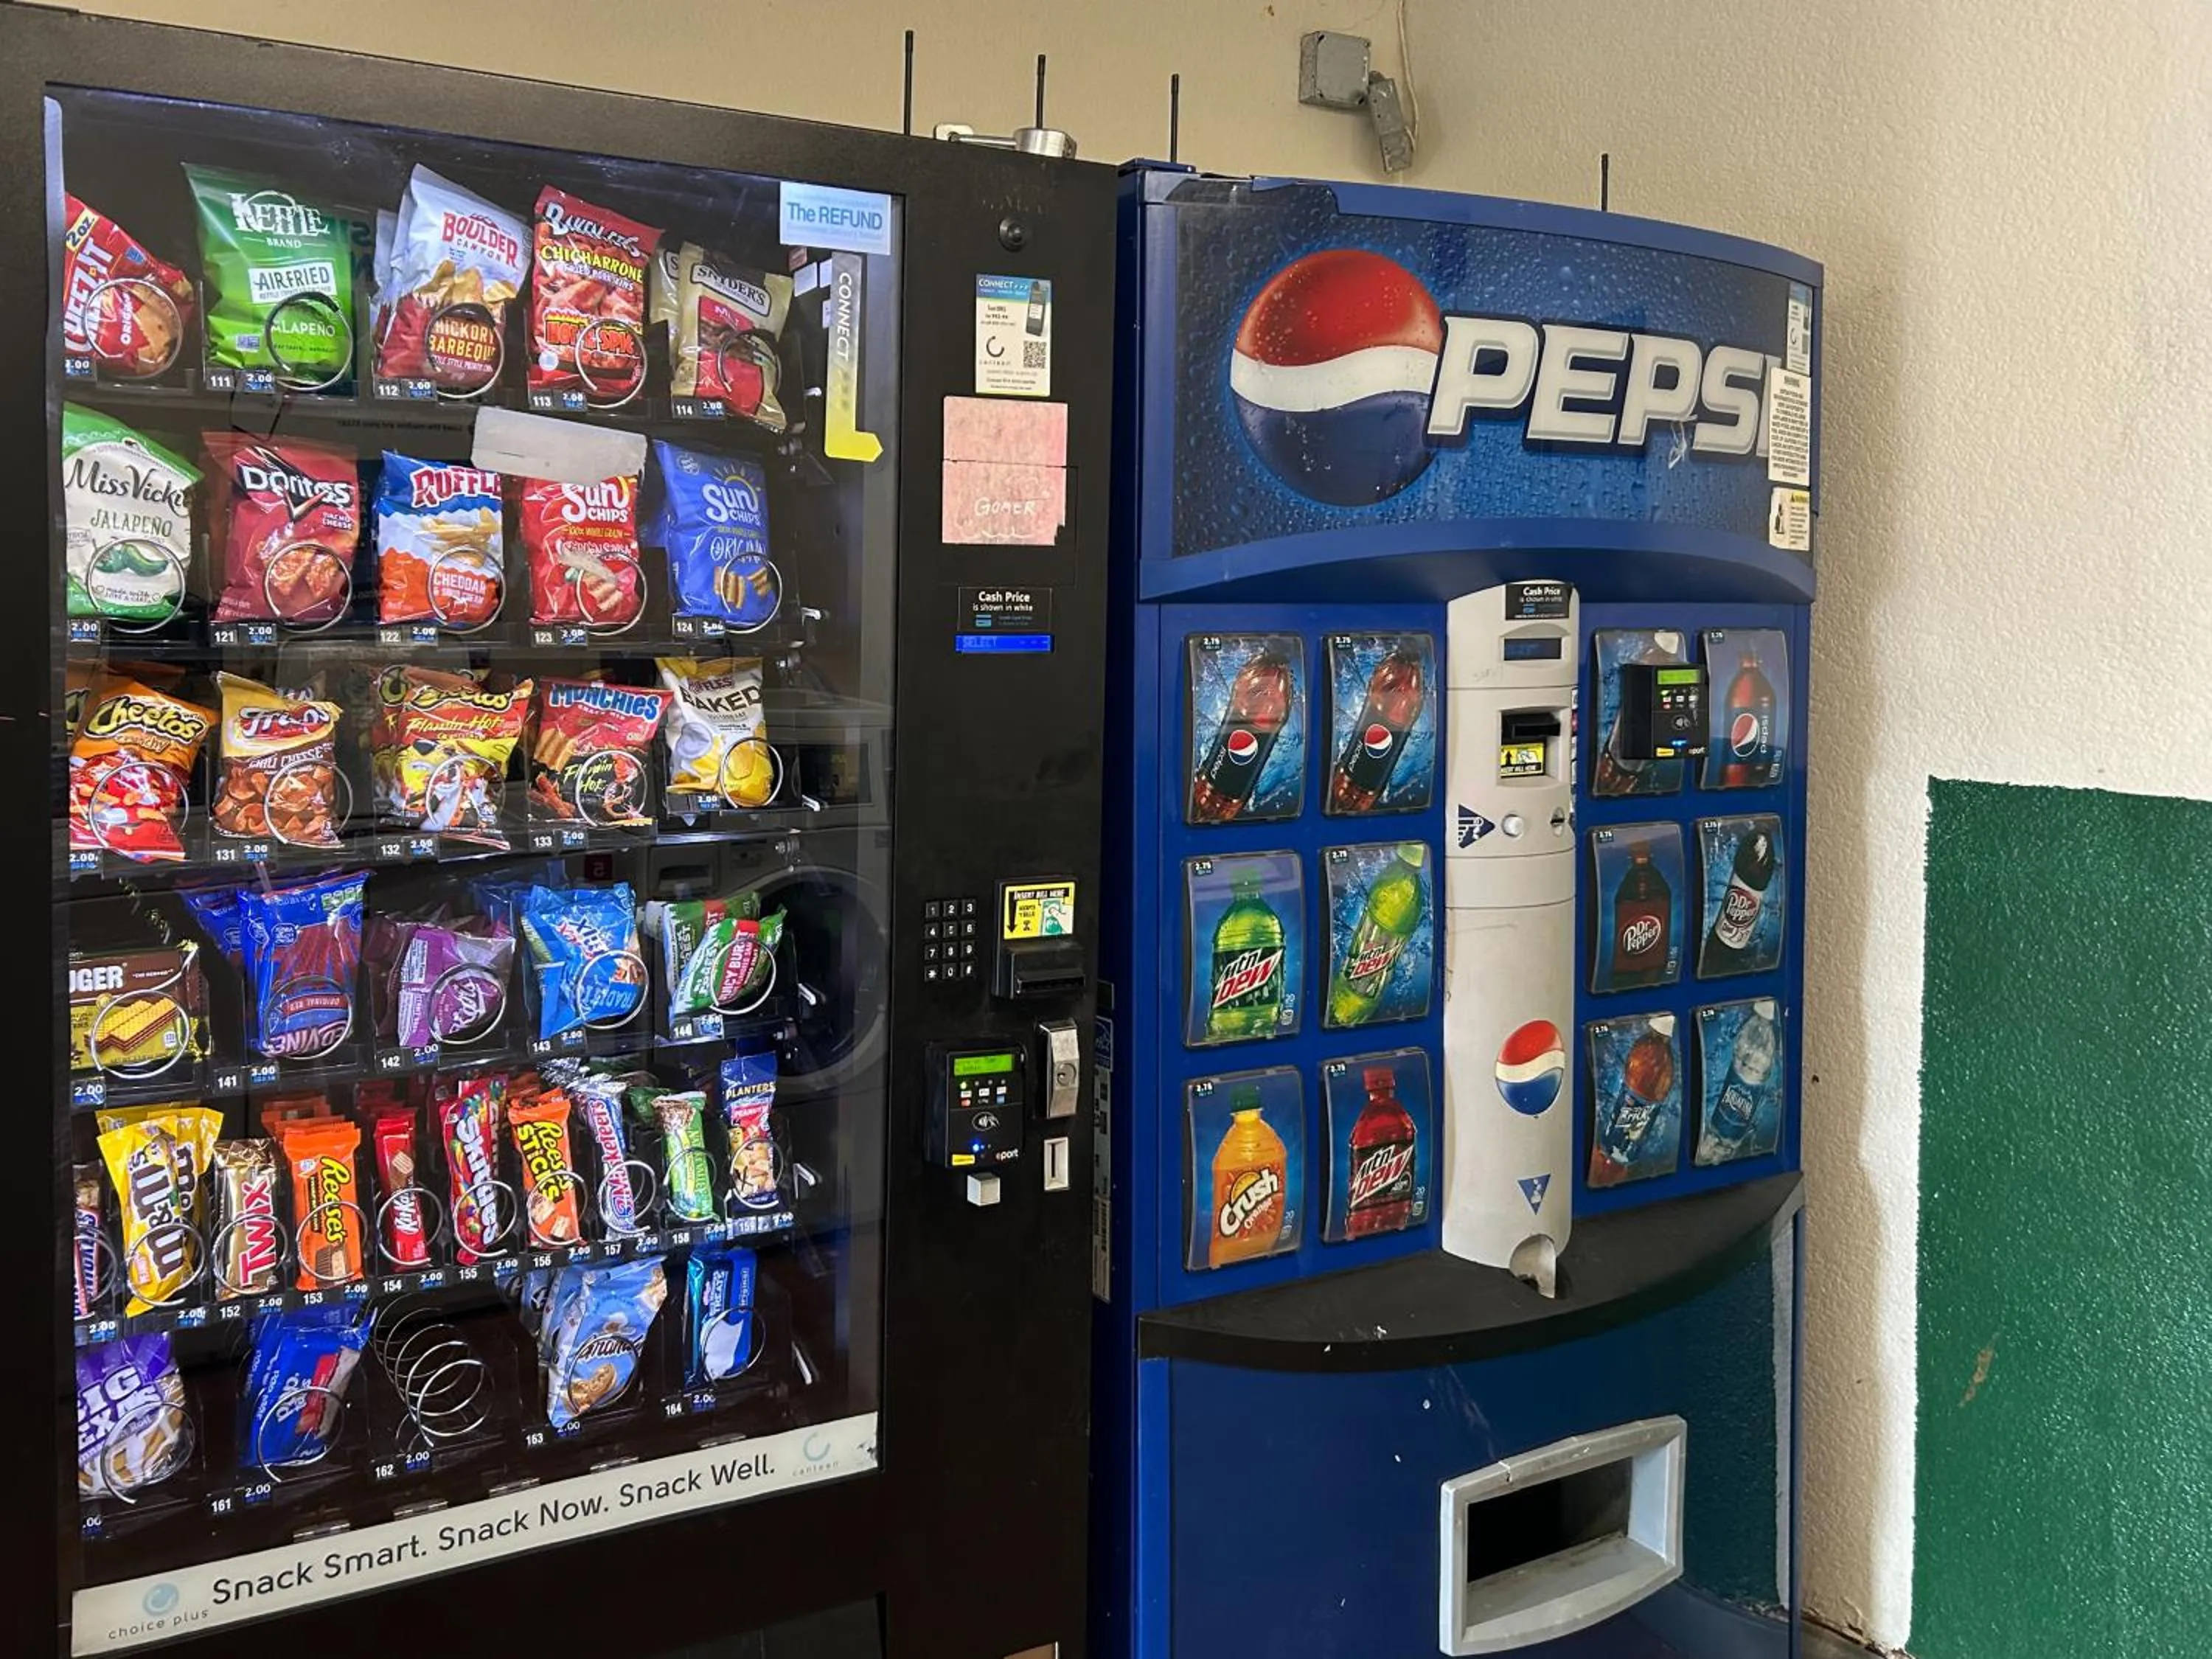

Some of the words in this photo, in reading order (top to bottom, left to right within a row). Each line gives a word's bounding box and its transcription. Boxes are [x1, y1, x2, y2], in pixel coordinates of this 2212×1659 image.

[787, 202, 815, 221] The
[818, 204, 883, 230] REFUND
[266, 237, 302, 248] BRAND
[443, 212, 518, 267] BOULDER
[456, 238, 502, 261] CANYON
[836, 272, 852, 361] CONNECT
[210, 375, 232, 387] 111
[247, 374, 273, 383] 2.00
[378, 384, 398, 396] 112
[1427, 315, 1782, 459] PEPSI
[532, 396, 552, 408] 113
[676, 404, 693, 415] 114
[66, 458, 129, 495] Miss
[238, 465, 351, 504] Doritos
[560, 481, 630, 523] Sun
[703, 483, 759, 523] Sun
[587, 508, 629, 524] CHIPS
[729, 511, 761, 525] CHIPS
[90, 508, 174, 538] JALAPEÑO
[434, 572, 487, 590] CHEDDAR
[978, 591, 1003, 602] Cash
[1005, 591, 1030, 602] Price
[1523, 586, 1543, 596] Cash
[1544, 586, 1561, 596] Price
[973, 603, 979, 611] is
[980, 603, 1004, 611] shown
[1005, 603, 1012, 611] in
[1014, 603, 1033, 611] white
[72, 622, 97, 633] 2.00
[249, 625, 273, 635] 2.00
[413, 627, 437, 635] 2.00
[676, 622, 692, 633] 124
[215, 630, 234, 642] 121
[380, 632, 399, 642] 122
[535, 632, 552, 643] 123
[549, 684, 661, 723] MUNCHIES
[679, 686, 762, 713] BAKED
[85, 693, 206, 742] Cheetos
[1760, 714, 1770, 754] pepsi
[279, 745, 324, 769] CHEESE
[533, 836, 552, 847] 133
[244, 844, 268, 853] 2.00
[380, 844, 400, 855] 132
[215, 849, 235, 861] 131
[1637, 919, 1650, 933] Dr
[1624, 924, 1658, 953] Pepper
[674, 1025, 692, 1036] 144
[414, 1043, 439, 1057] 2.00
[532, 1041, 551, 1052] 143
[381, 1057, 400, 1068] 142
[218, 1076, 237, 1088] 141
[74, 1085, 103, 1096] 2.00
[726, 1082, 776, 1099] PLANTERS
[320, 1156, 350, 1244] Reese's
[1219, 1166, 1279, 1237] Crush
[239, 1181, 277, 1287] TWIX
[672, 1232, 690, 1244] 158
[604, 1244, 622, 1256] 157
[496, 1259, 518, 1269] 2.00
[532, 1256, 552, 1268] 156
[420, 1272, 443, 1282] 2.00
[459, 1268, 478, 1280] 155
[344, 1284, 368, 1294] 2.00
[383, 1281, 402, 1293] 154
[259, 1297, 283, 1307] 2.00
[303, 1293, 323, 1304] 153
[220, 1305, 240, 1318] 152
[692, 1394, 716, 1404] 2.00
[665, 1402, 682, 1416] 164
[526, 1432, 545, 1445] 163
[406, 1450, 431, 1463] 2.00
[375, 1464, 394, 1478] 162
[792, 1459, 840, 1476] canteen
[244, 1484, 271, 1498] 2.00
[212, 1498, 232, 1513] 161
[212, 1562, 314, 1605] Snack
[324, 1534, 427, 1579] Smart.
[437, 1509, 529, 1551] Snack
[538, 1493, 609, 1529] Now.
[619, 1470, 703, 1508] Snack
[711, 1453, 775, 1487] Well.
[108, 1619, 166, 1641] choice
[173, 1608, 209, 1628] plus
